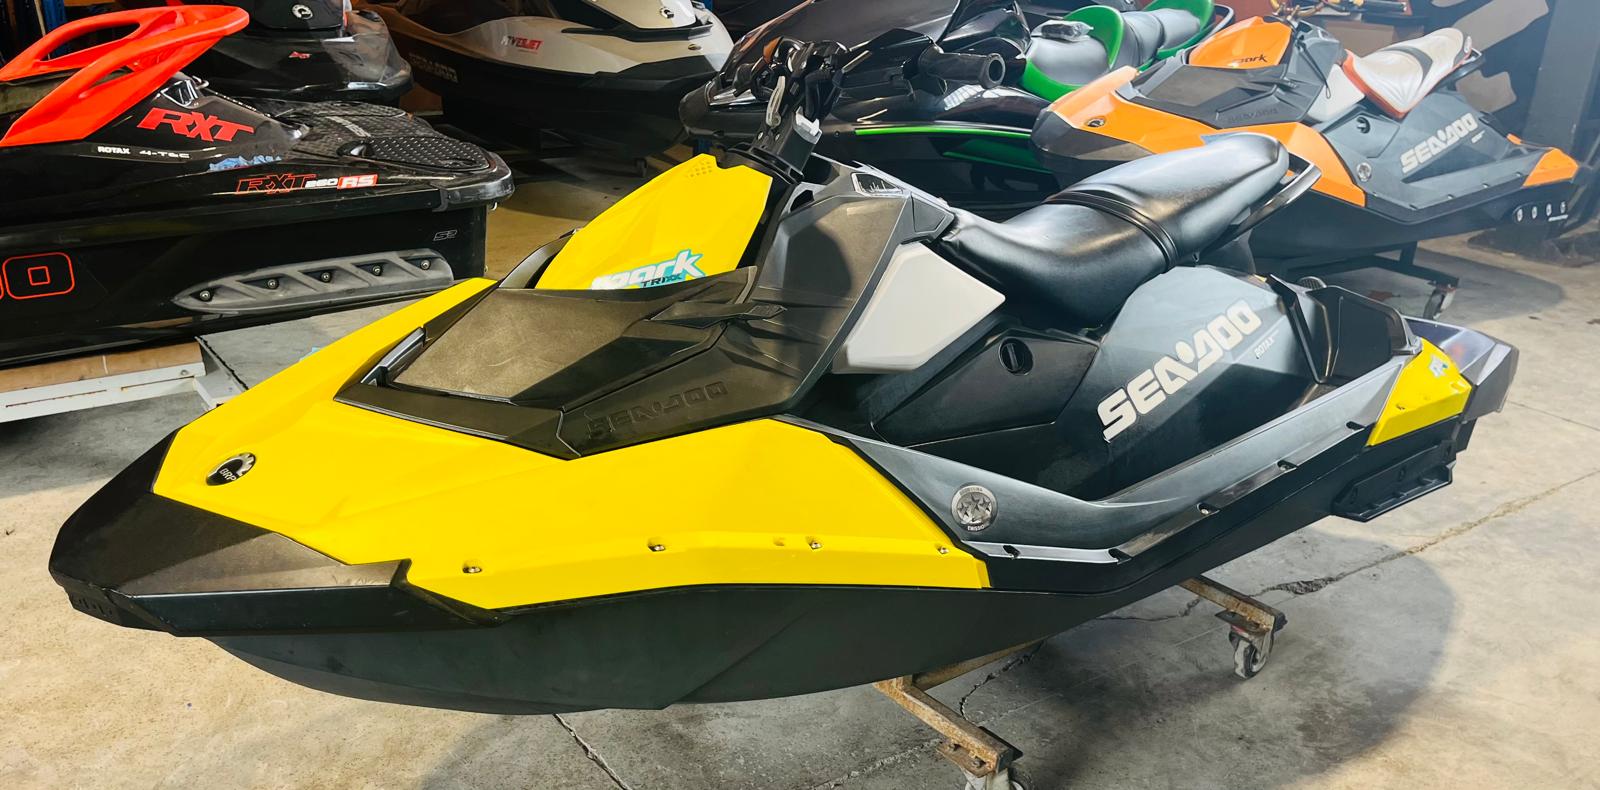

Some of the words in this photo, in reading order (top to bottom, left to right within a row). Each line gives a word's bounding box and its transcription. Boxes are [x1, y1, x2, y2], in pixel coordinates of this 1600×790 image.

[137, 107, 255, 142] RXT
[97, 146, 131, 155] ROTAX
[218, 467, 237, 481] BRP
